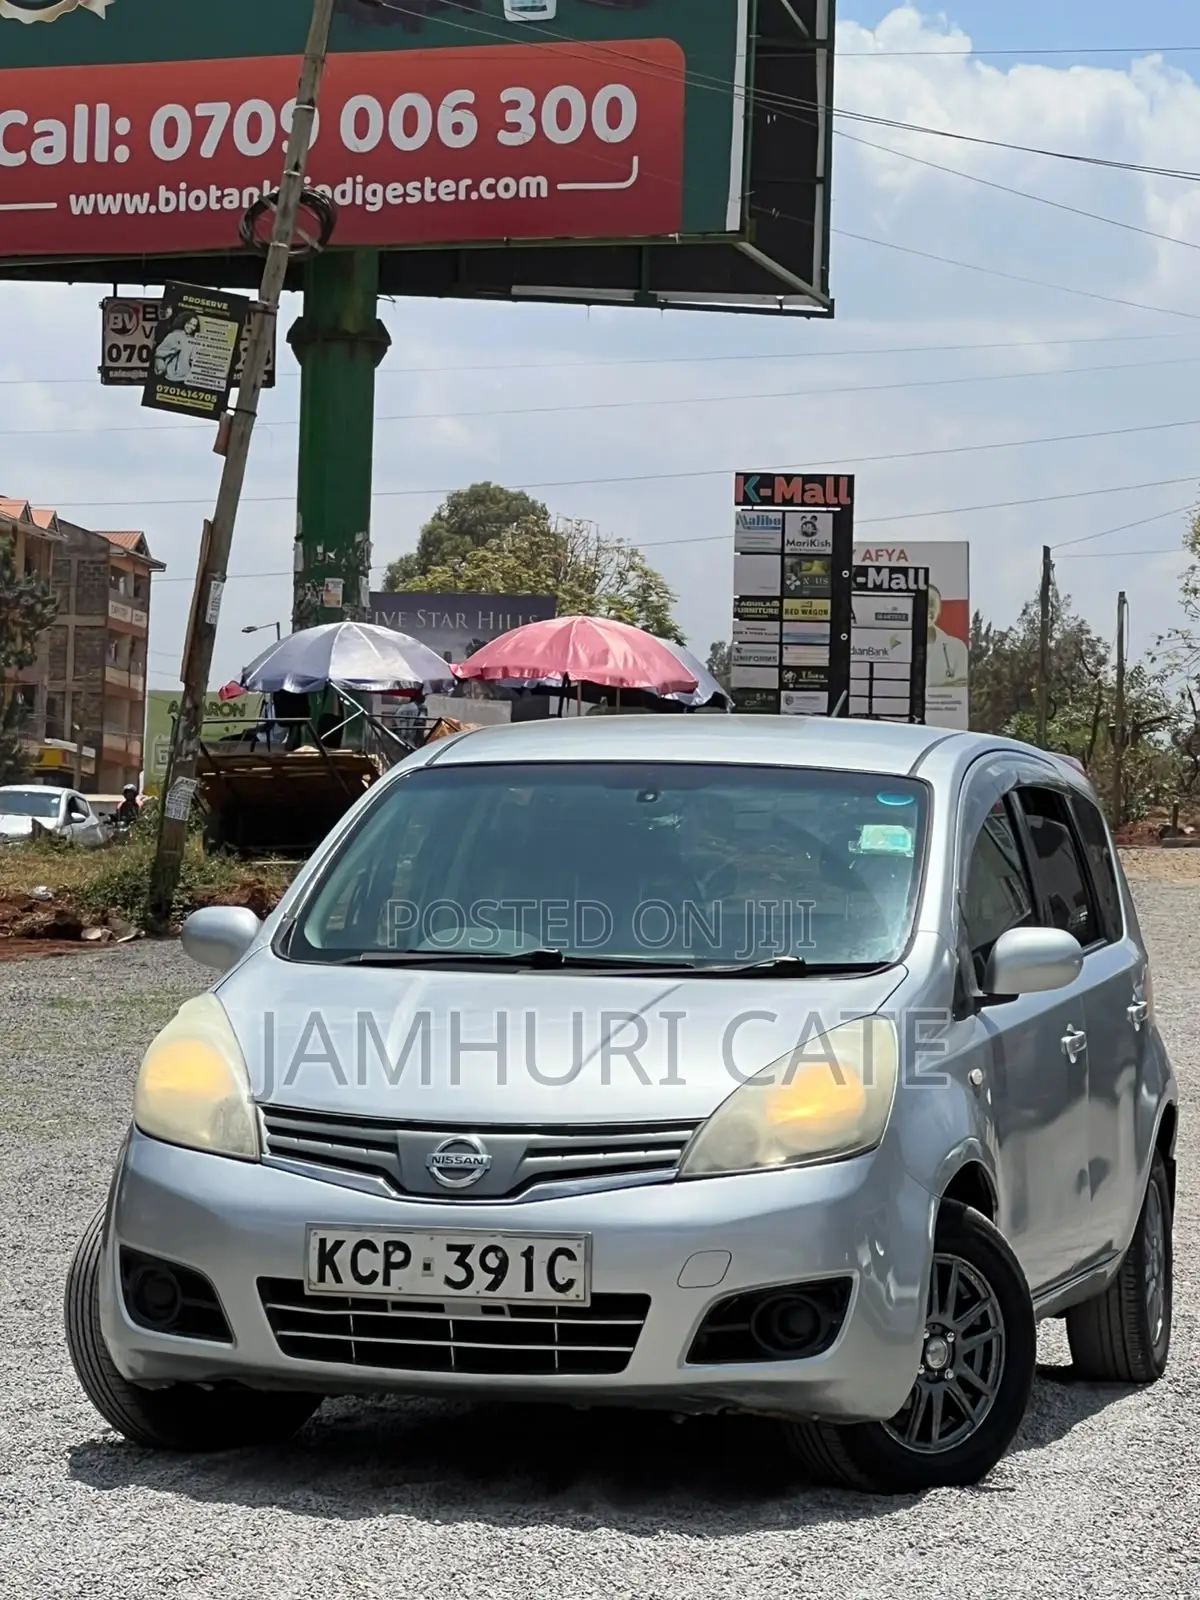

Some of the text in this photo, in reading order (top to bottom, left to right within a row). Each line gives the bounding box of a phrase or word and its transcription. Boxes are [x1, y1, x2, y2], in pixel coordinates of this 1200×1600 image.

[0, 103, 131, 167] Call:
[340, 89, 478, 153] 006
[497, 83, 637, 146] 300
[183, 295, 229, 310] PROSERVE
[109, 312, 134, 329] BV
[735, 475, 851, 505] K-Mall
[861, 548, 909, 563] AFYA
[851, 567, 928, 591] -Mall
[416, 609, 469, 630] STAR
[168, 700, 246, 717] AARON
[431, 1154, 484, 1166] NISSAN
[317, 1237, 578, 1295] KCP 391C
